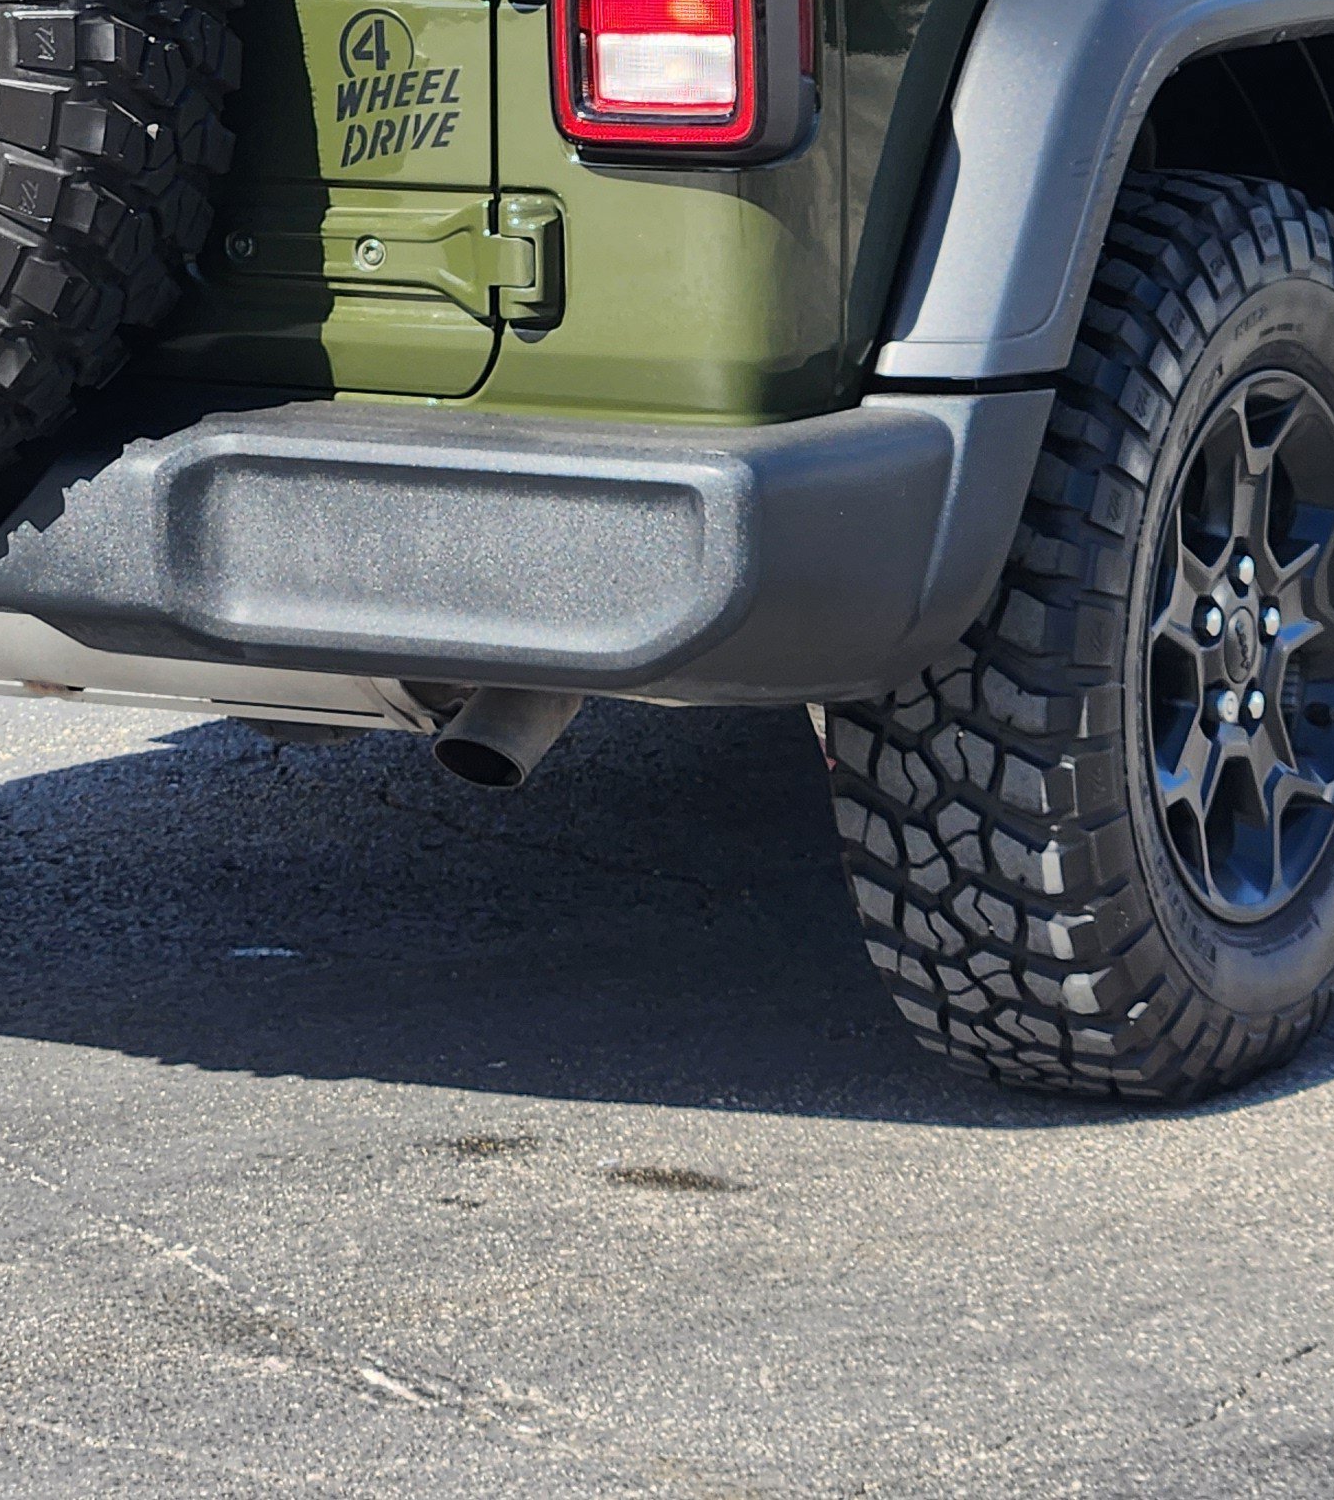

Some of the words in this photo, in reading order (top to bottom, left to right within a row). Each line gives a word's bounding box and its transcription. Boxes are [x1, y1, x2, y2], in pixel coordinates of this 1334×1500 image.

[351, 18, 391, 71] 4
[336, 67, 462, 123] WHEEL
[340, 110, 461, 168] DRIVE
